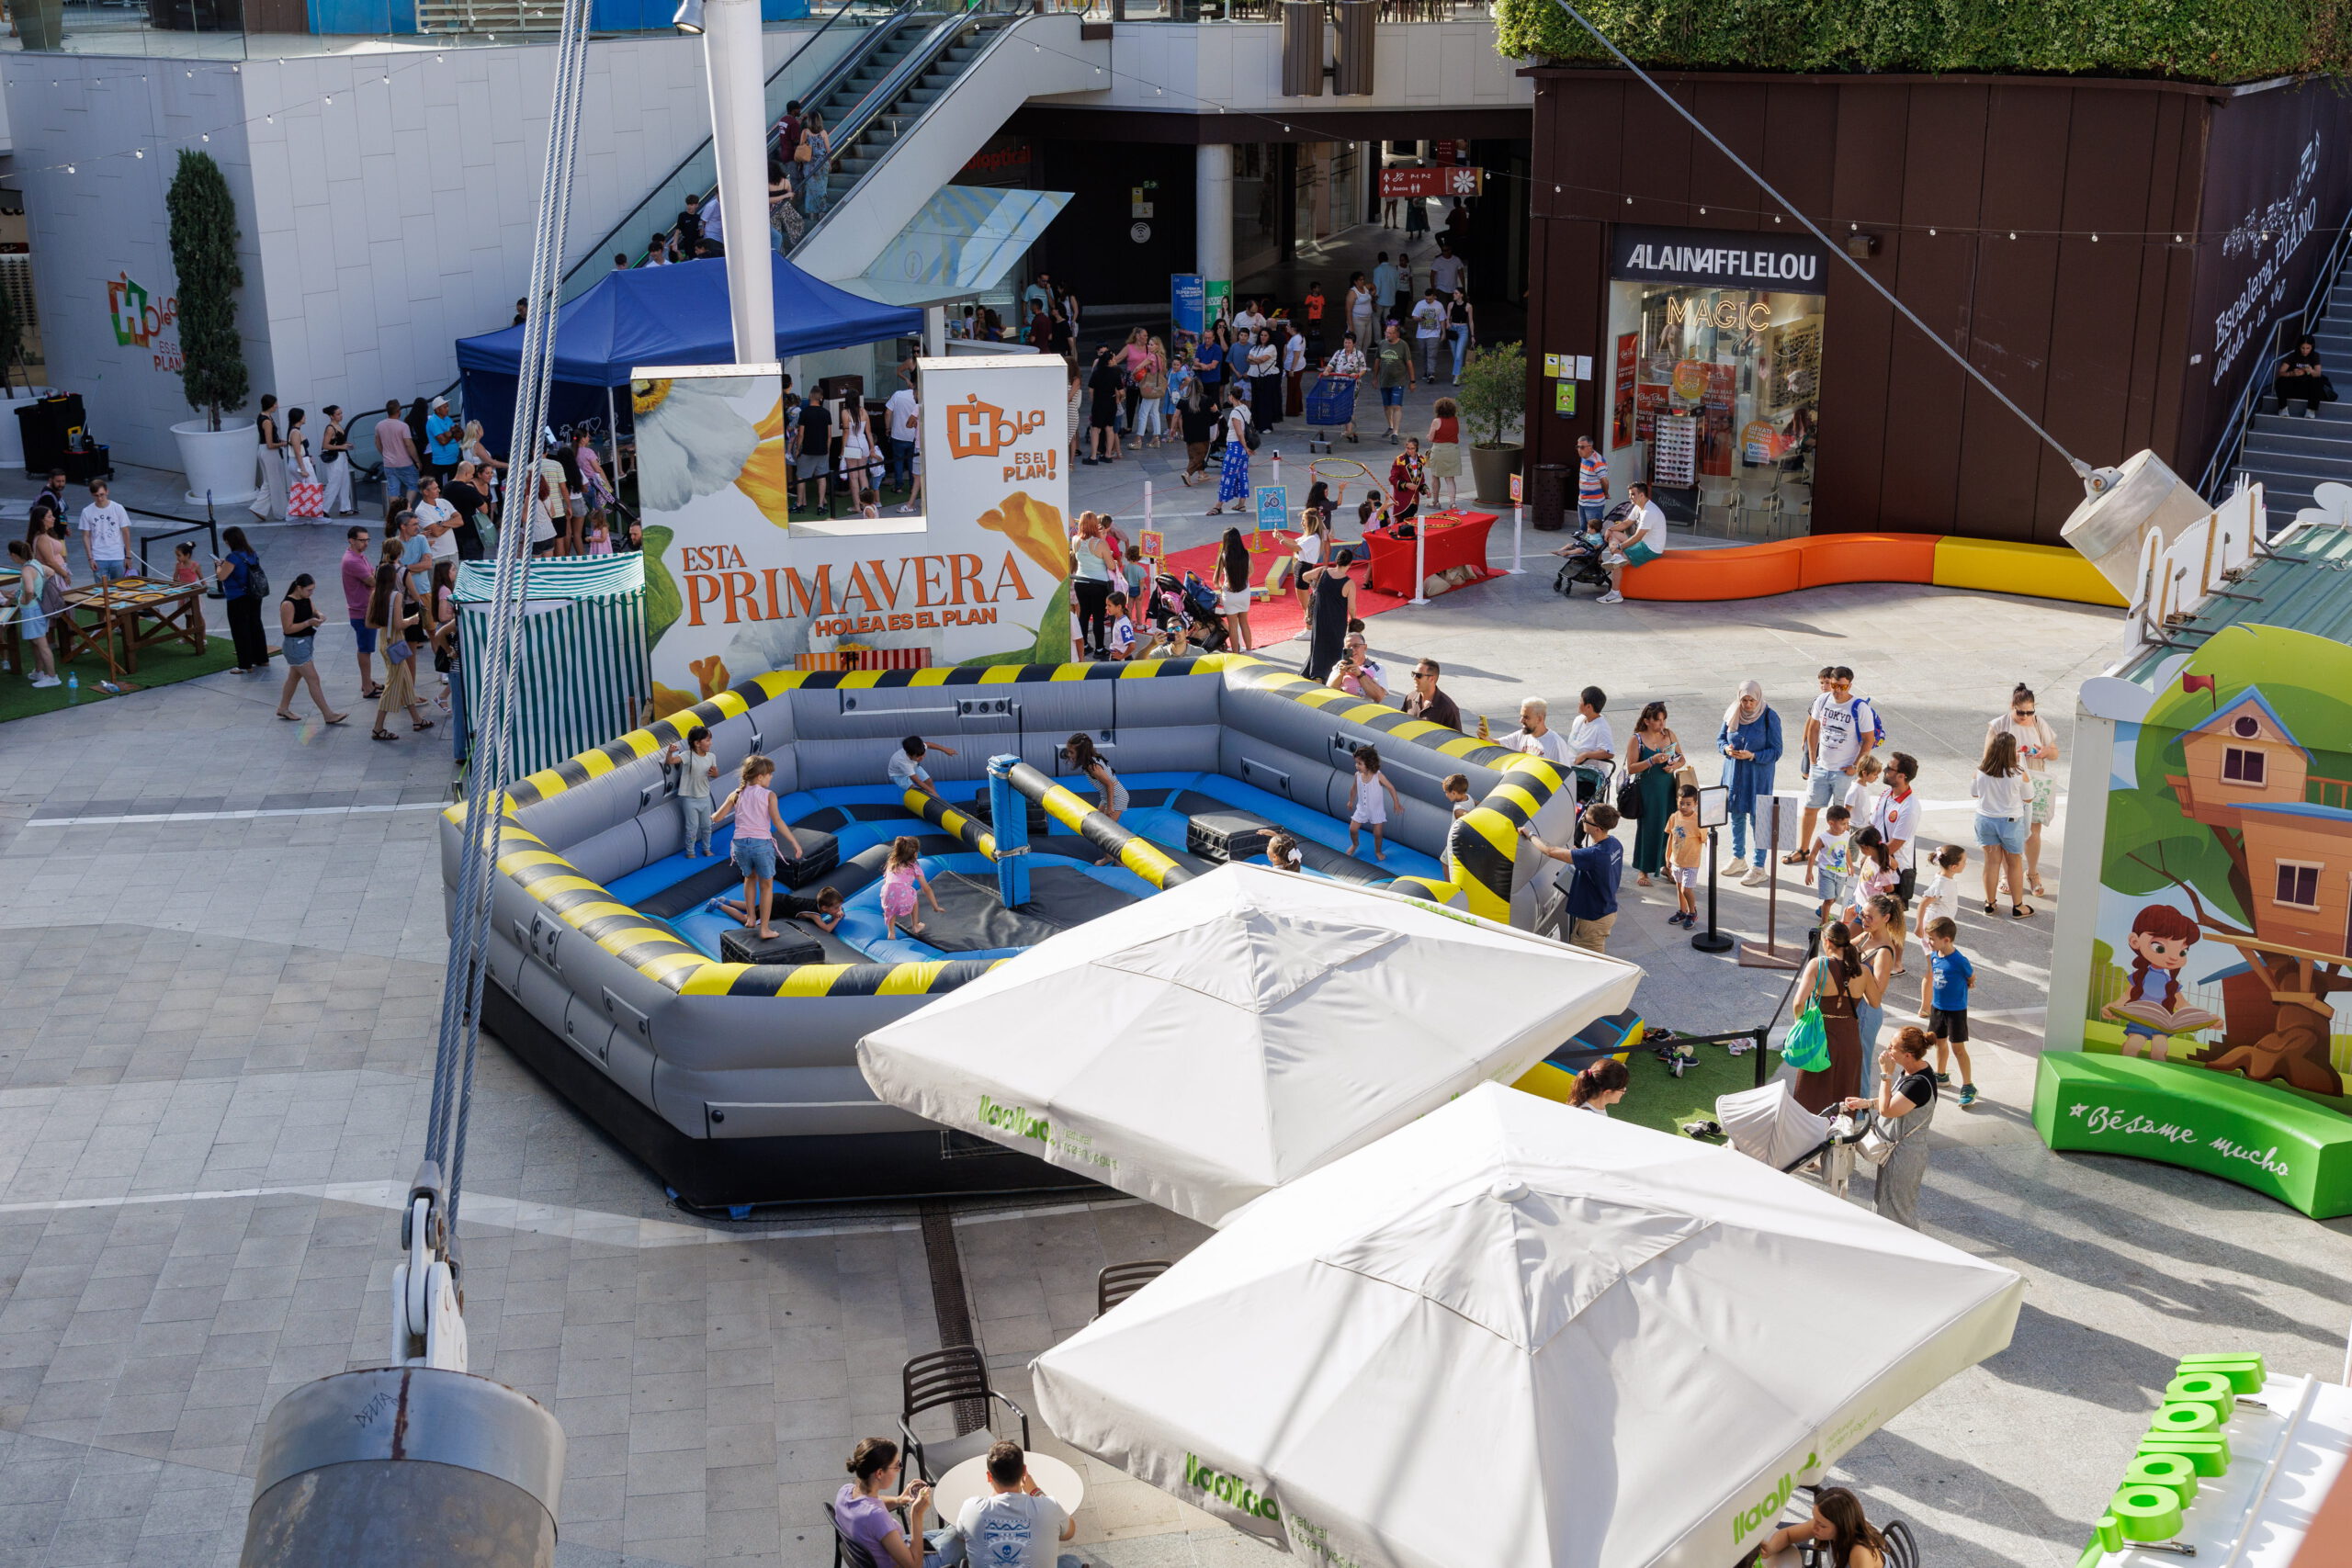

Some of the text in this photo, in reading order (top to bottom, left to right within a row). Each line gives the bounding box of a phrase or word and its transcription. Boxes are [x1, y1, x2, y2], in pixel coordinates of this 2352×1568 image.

[962, 145, 1032, 172] oloptical
[2214, 197, 2316, 353] Escalera PIANO
[1667, 296, 1771, 332] MAGIC
[159, 340, 170, 354] ES
[956, 405, 1046, 451] Holea
[1014, 451, 1046, 465] ES EL
[681, 544, 748, 572] ESTA
[683, 549, 1035, 626] PRIMAVERA
[815, 607, 998, 637] HOLEA ES EL PLAN
[1824, 707, 1851, 723] TOKYO
[2087, 1105, 2289, 1177] Bésame mucho
[1289, 1512, 1328, 1540] natural
[1289, 1526, 1324, 1555] frozen
